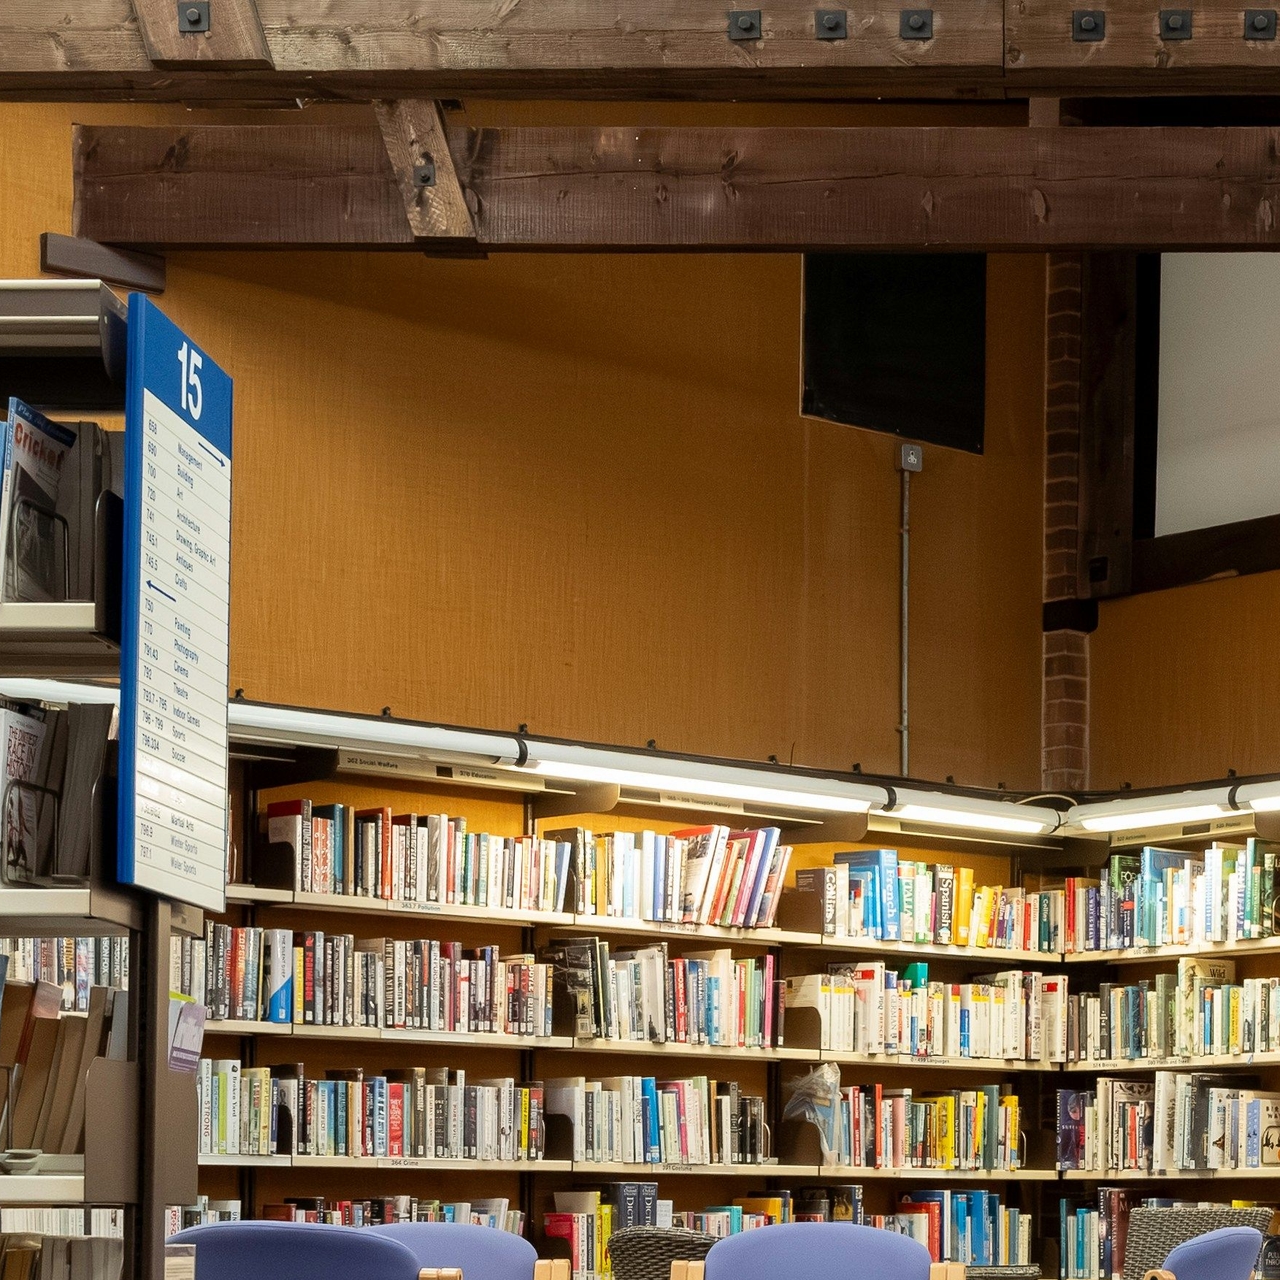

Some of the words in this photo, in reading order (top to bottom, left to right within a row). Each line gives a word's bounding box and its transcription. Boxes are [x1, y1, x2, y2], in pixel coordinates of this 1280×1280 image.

[178, 342, 203, 420] 15
[148, 419, 157, 435] 658
[178, 443, 202, 471] Management
[147, 463, 156, 479] 700
[177, 465, 193, 488] Building
[147, 486, 156, 501] 720
[175, 573, 187, 591] Crafts
[145, 598, 153, 613] 750
[175, 617, 191, 639] Painting
[174, 639, 199, 664] Photography
[174, 660, 189, 678] Cinema
[172, 726, 186, 742] Sports
[172, 748, 185, 763] Soccer
[825, 873, 836, 922] Collins
[886, 869, 896, 917] French
[941, 879, 952, 926] Spanish
[1210, 967, 1225, 979] Wild
